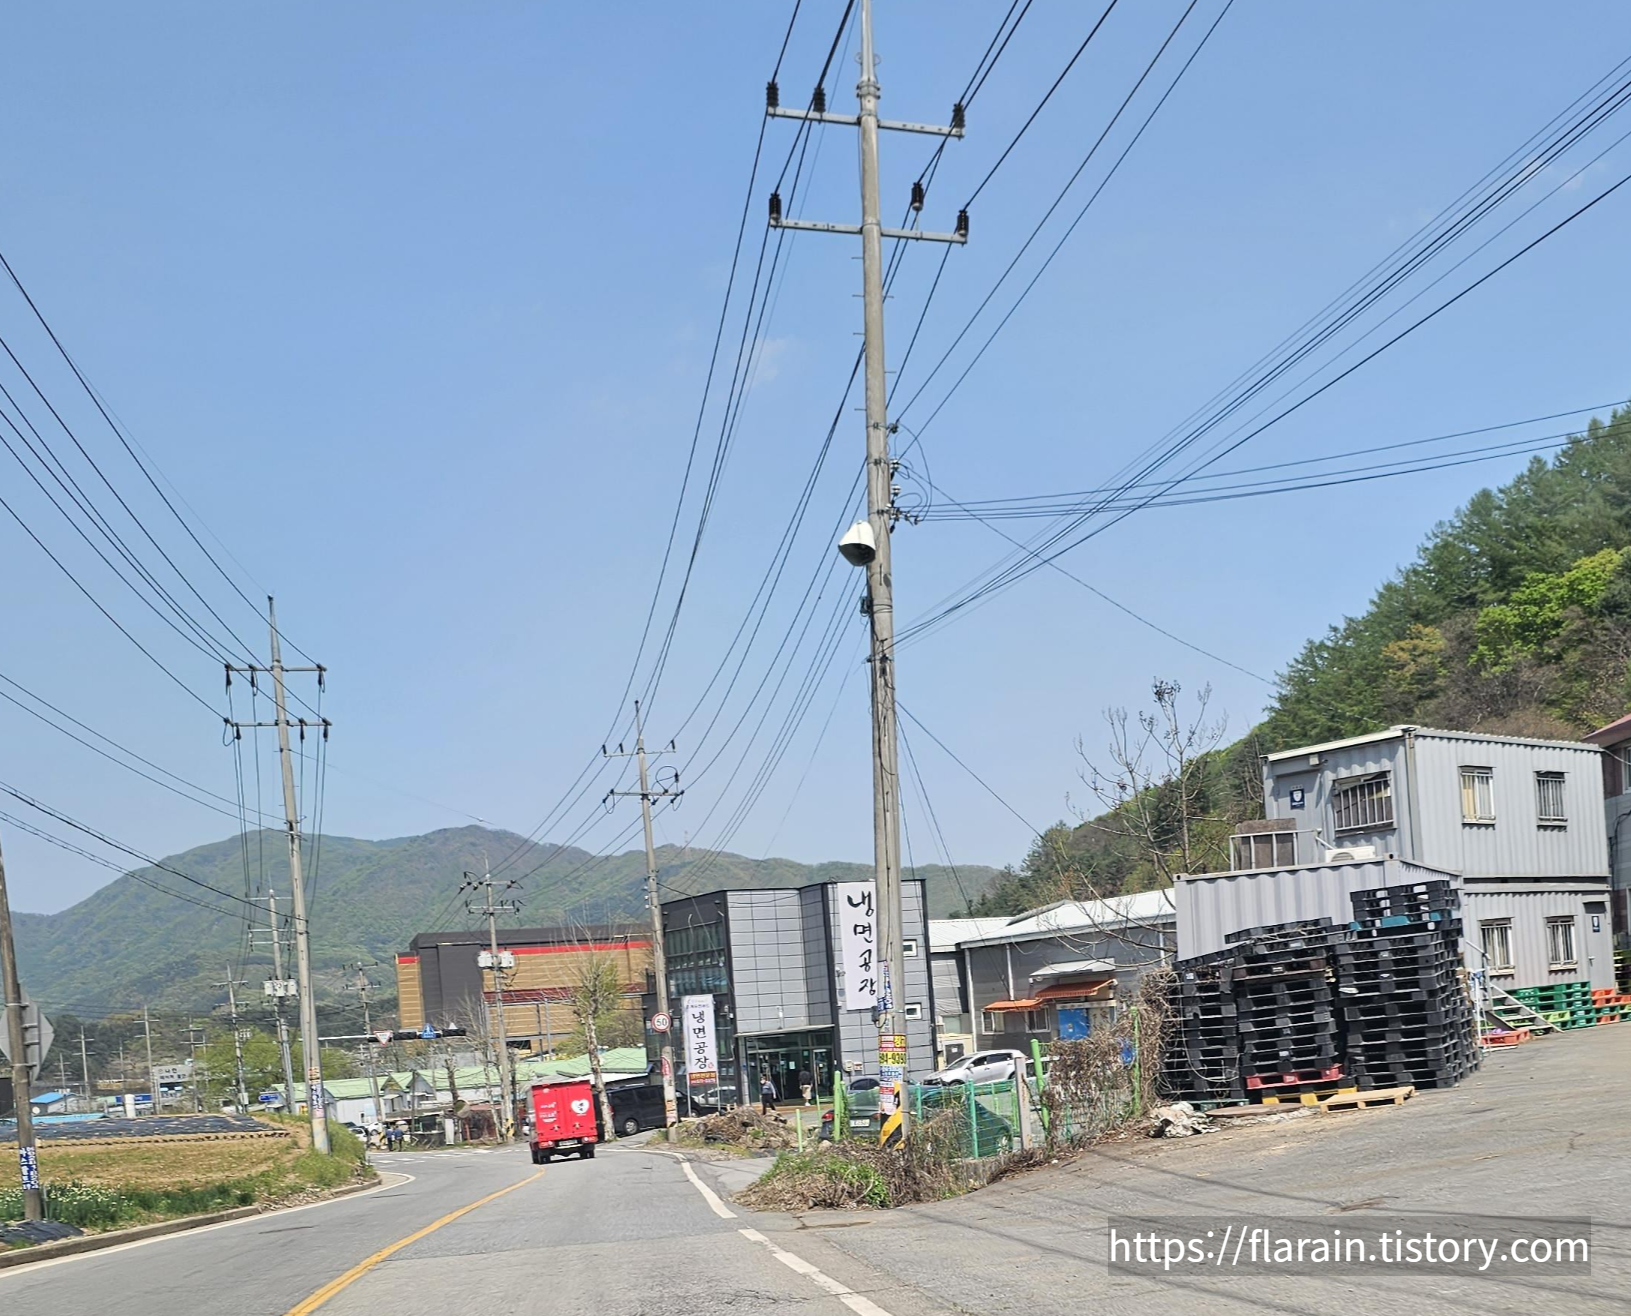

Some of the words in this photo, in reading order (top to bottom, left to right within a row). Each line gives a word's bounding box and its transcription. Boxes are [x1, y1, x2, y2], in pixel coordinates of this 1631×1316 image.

[847, 891, 876, 995] 냉면공장
[656, 1018, 668, 1027] 50
[692, 1011, 709, 1069] 냉면공장
